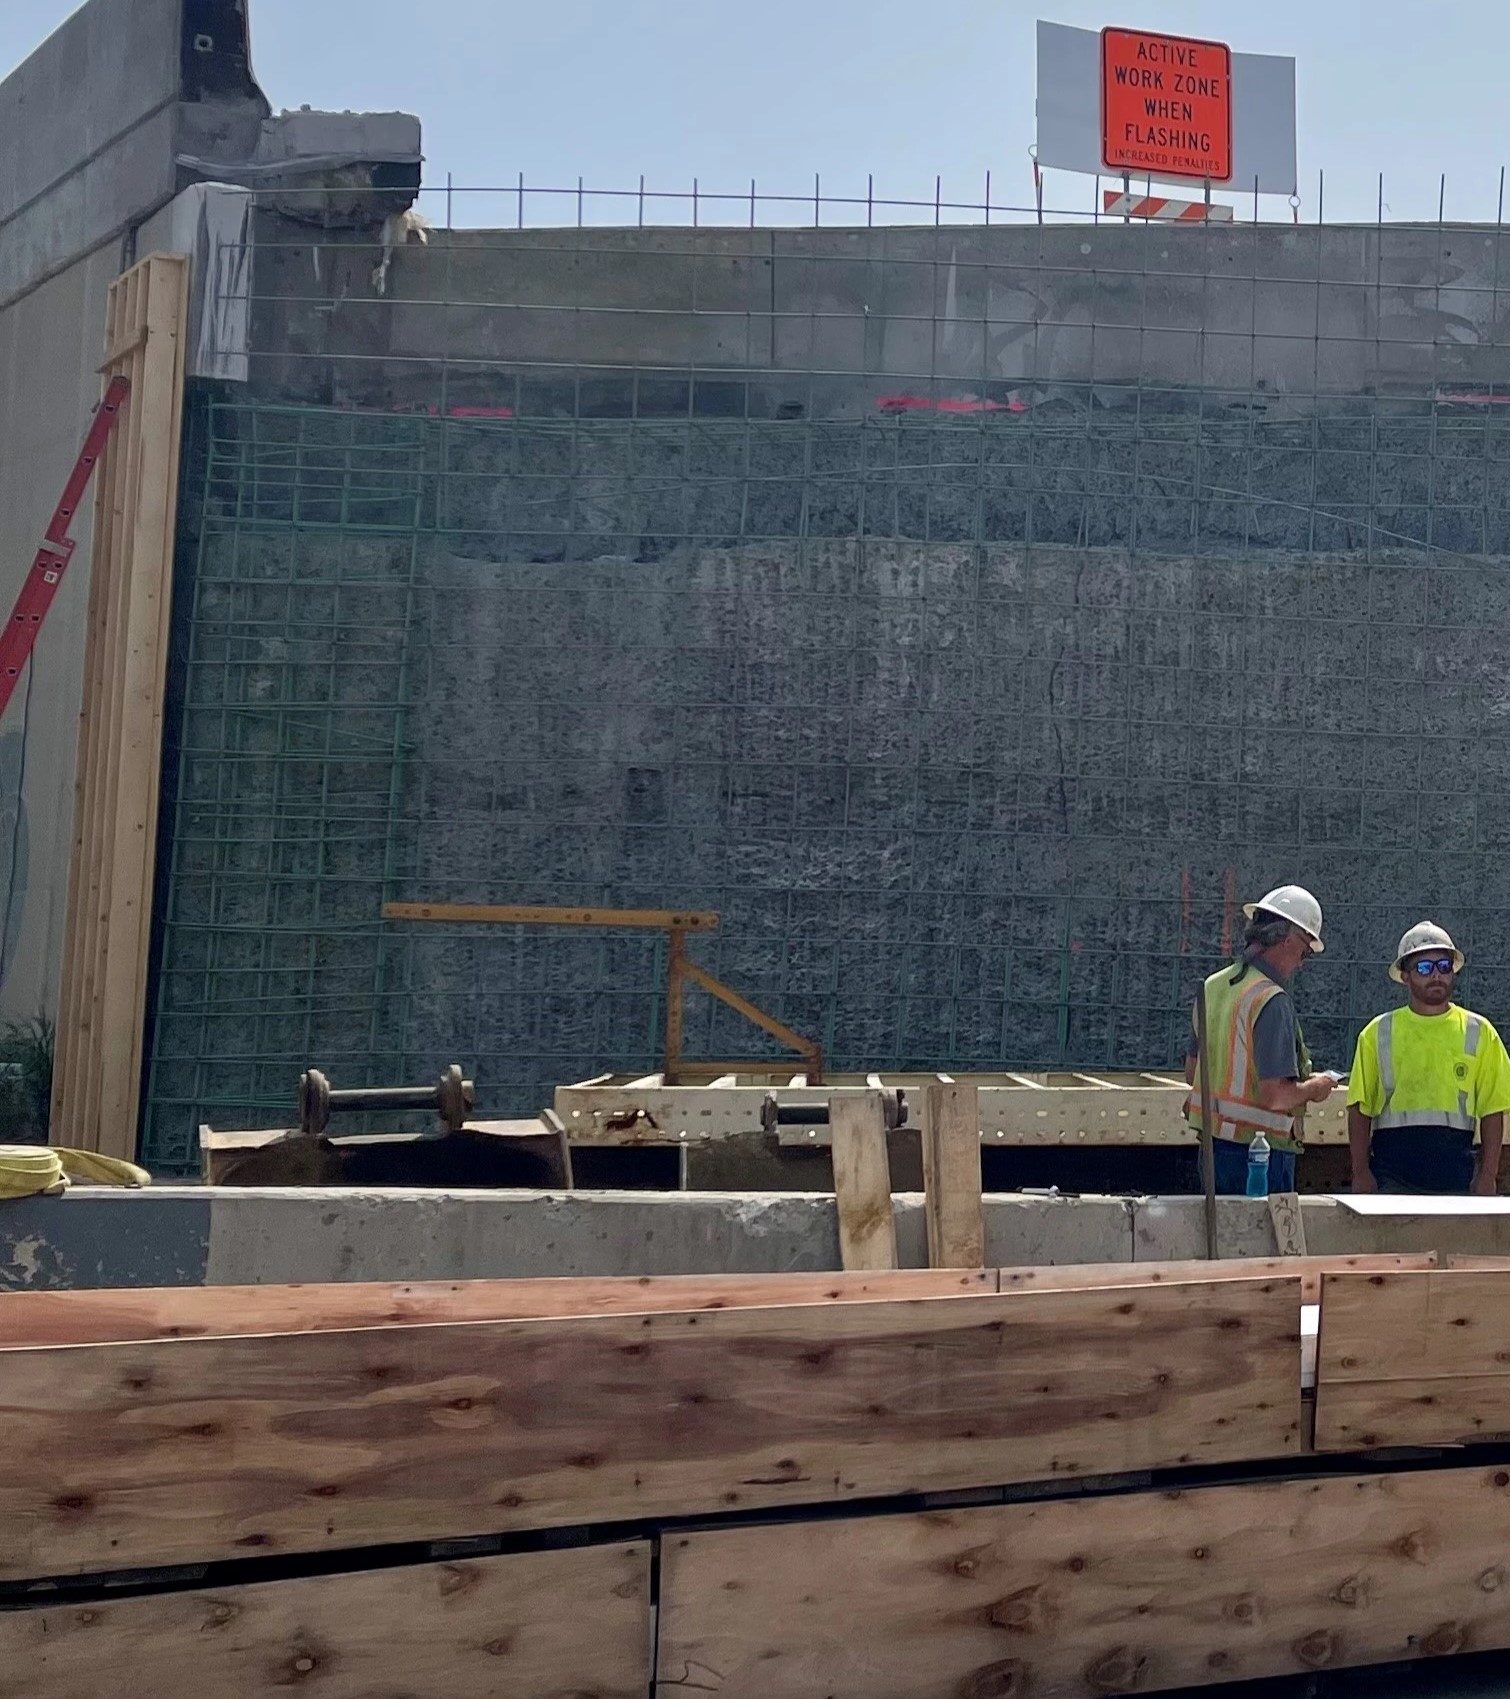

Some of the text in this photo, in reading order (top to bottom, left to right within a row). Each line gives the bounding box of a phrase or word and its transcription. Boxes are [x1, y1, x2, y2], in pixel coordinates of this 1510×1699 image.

[1137, 42, 1198, 67] ACTIVE
[1114, 65, 1220, 98] WORK ZONE
[1144, 98, 1192, 122] WHEN
[1125, 123, 1210, 152] FLASHING
[1115, 149, 1220, 171] INCREASED PENALTIES
